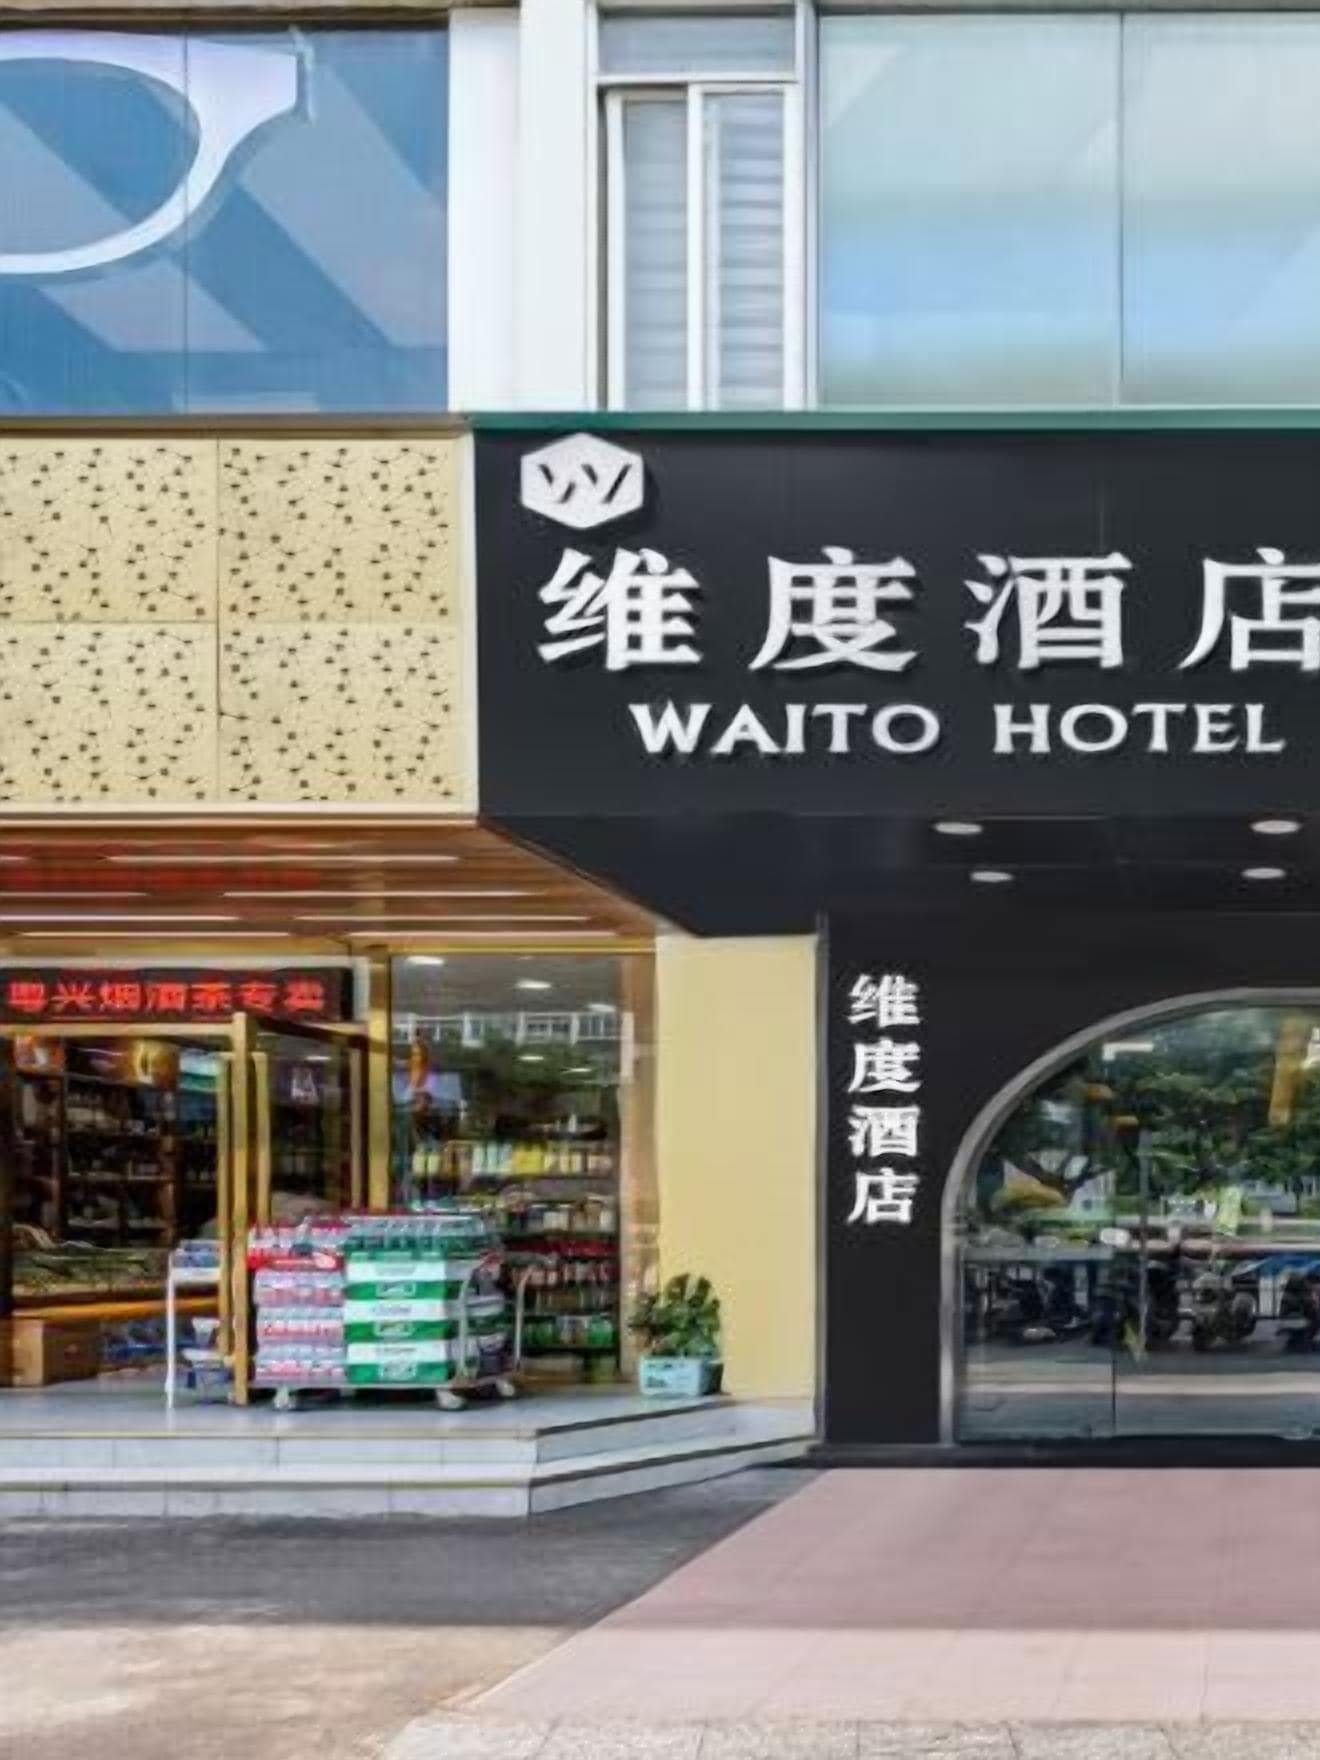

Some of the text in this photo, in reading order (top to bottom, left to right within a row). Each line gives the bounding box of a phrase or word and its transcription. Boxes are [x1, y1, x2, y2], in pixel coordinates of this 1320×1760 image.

[628, 701, 1286, 754] WAITO HOTEL
[847, 974, 921, 1224] 维度酒店
